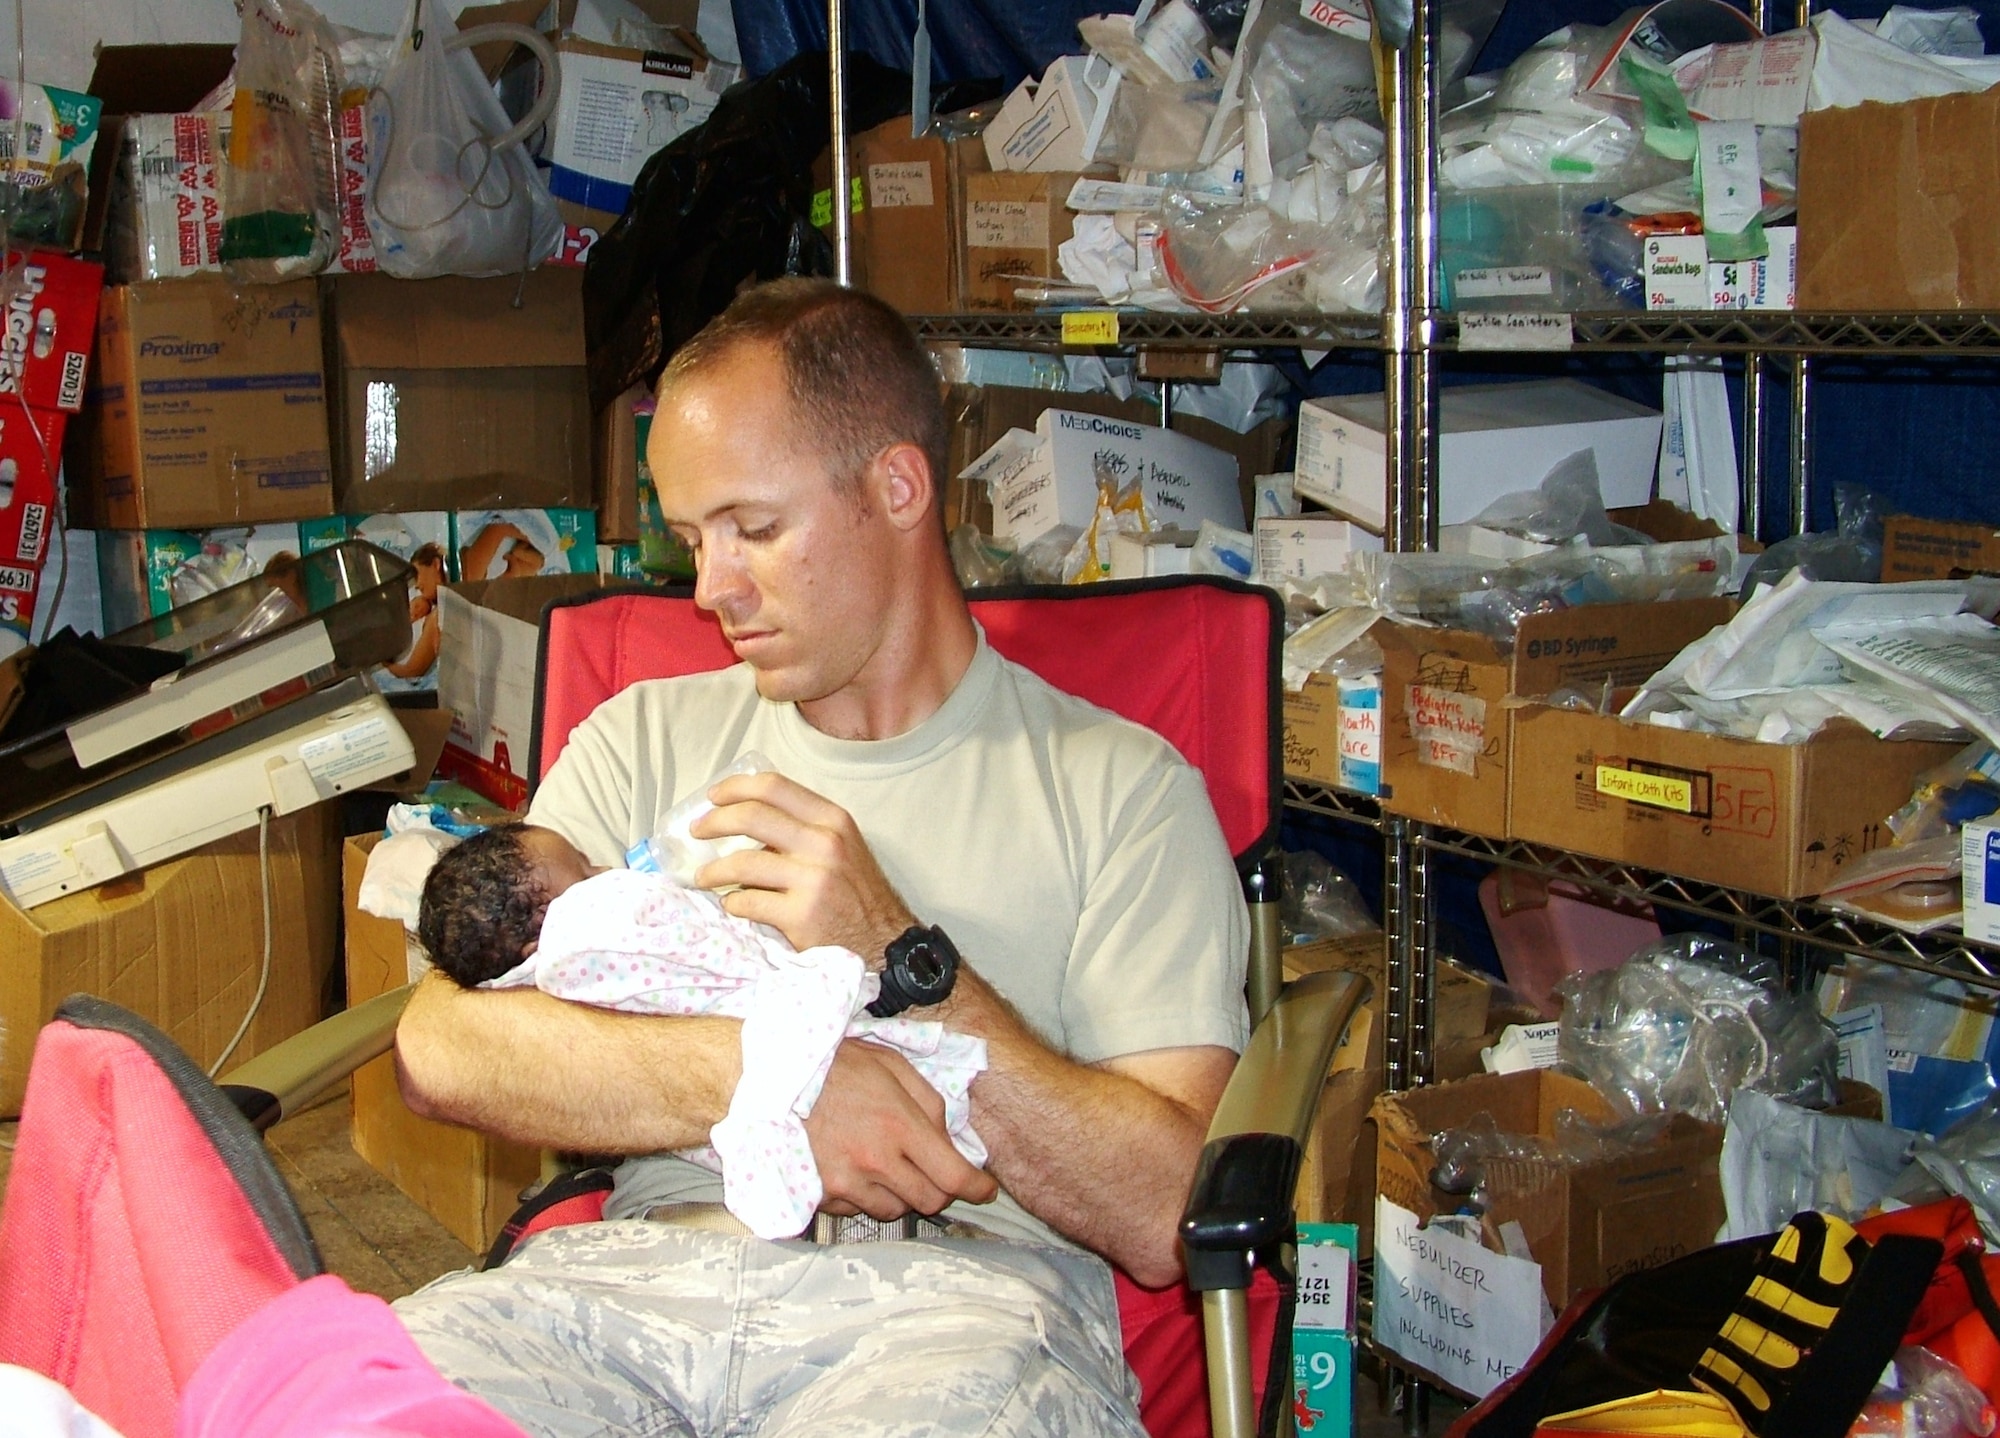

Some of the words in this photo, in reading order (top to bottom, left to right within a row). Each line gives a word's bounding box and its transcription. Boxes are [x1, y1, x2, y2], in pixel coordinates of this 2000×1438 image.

[645, 59, 691, 74] KIRKLAND
[76, 104, 92, 127] 3
[1651, 262, 1684, 276] Sandwich
[1684, 262, 1701, 281] Bags
[1754, 263, 1766, 306] Freezer
[1651, 292, 1665, 304] 50
[1714, 291, 1730, 304] 50
[1463, 312, 1502, 329] Suction
[1506, 313, 1562, 328] Canisters
[139, 340, 221, 358] Proxima
[61, 353, 84, 390] 52670
[20, 504, 43, 545] 52670
[1542, 638, 1563, 657] BD
[1565, 635, 1618, 658] Syringe
[1411, 685, 1463, 716] Pediatric
[1338, 708, 1376, 733] Mouth
[1340, 732, 1371, 758] Care
[1600, 770, 1634, 792] Infant
[1636, 778, 1661, 798] Cath
[1662, 783, 1685, 803] Kits
[1395, 1226, 1493, 1295] NEBULIZER
[1399, 1276, 1475, 1329] SUPPLIES
[1399, 1315, 1476, 1365] INCLUDING
[1309, 1351, 1337, 1391] 6
